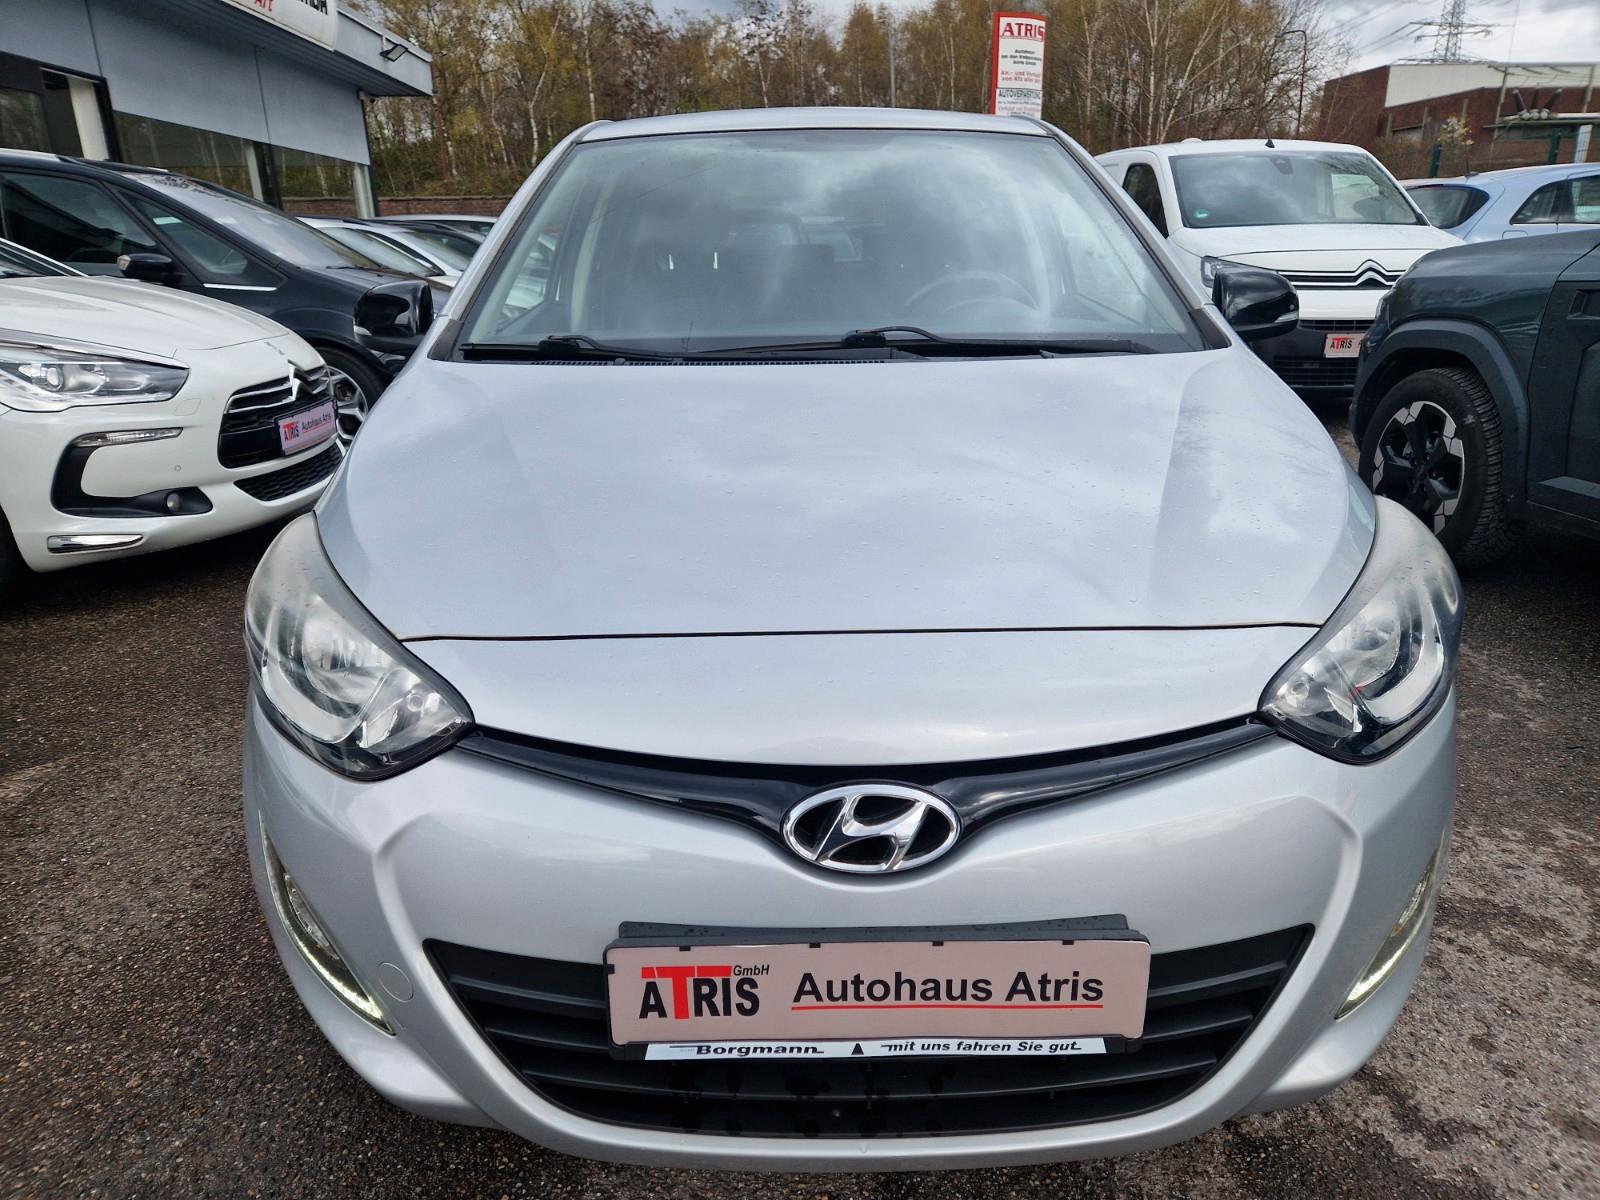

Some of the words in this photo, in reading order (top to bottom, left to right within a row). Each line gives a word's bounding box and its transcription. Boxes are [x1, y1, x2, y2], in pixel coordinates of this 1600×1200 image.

[1001, 22, 1045, 39] ATRIS
[1329, 337, 1353, 349] ATRIS
[283, 422, 300, 441] ATRIS
[639, 965, 760, 1020] ATRIS
[733, 965, 770, 976] GmbH
[793, 971, 993, 1003] Autohaus
[1005, 970, 1104, 1002] Atris
[696, 1045, 824, 1057] Borgmann
[886, 1041, 916, 1052] mit
[921, 1043, 951, 1051] uns
[956, 1041, 1012, 1052] fahren
[1017, 1041, 1043, 1052] Sie
[1049, 1041, 1081, 1053] gut
